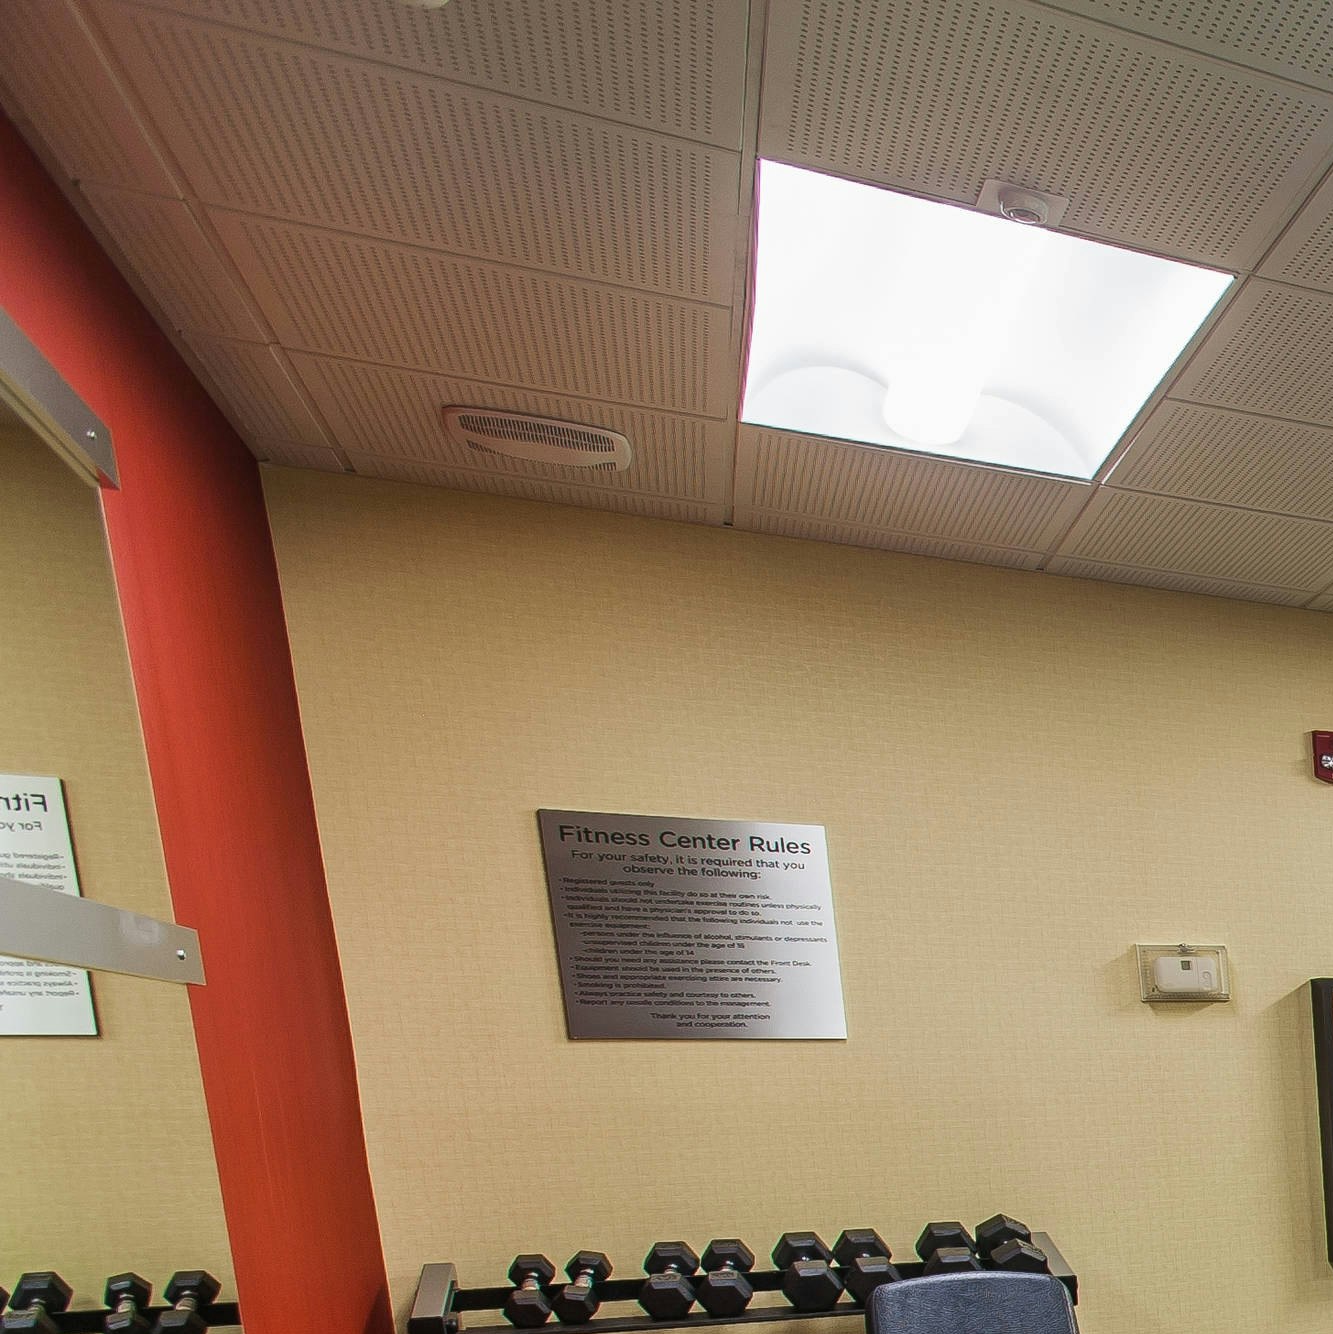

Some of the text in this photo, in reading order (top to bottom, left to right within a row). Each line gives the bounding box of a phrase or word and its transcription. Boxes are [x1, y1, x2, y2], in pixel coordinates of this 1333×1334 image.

[559, 825, 812, 854] Fitness Center Rules
[571, 849, 805, 870] For your safety, it is required that you
[623, 864, 762, 880] observe the following:
